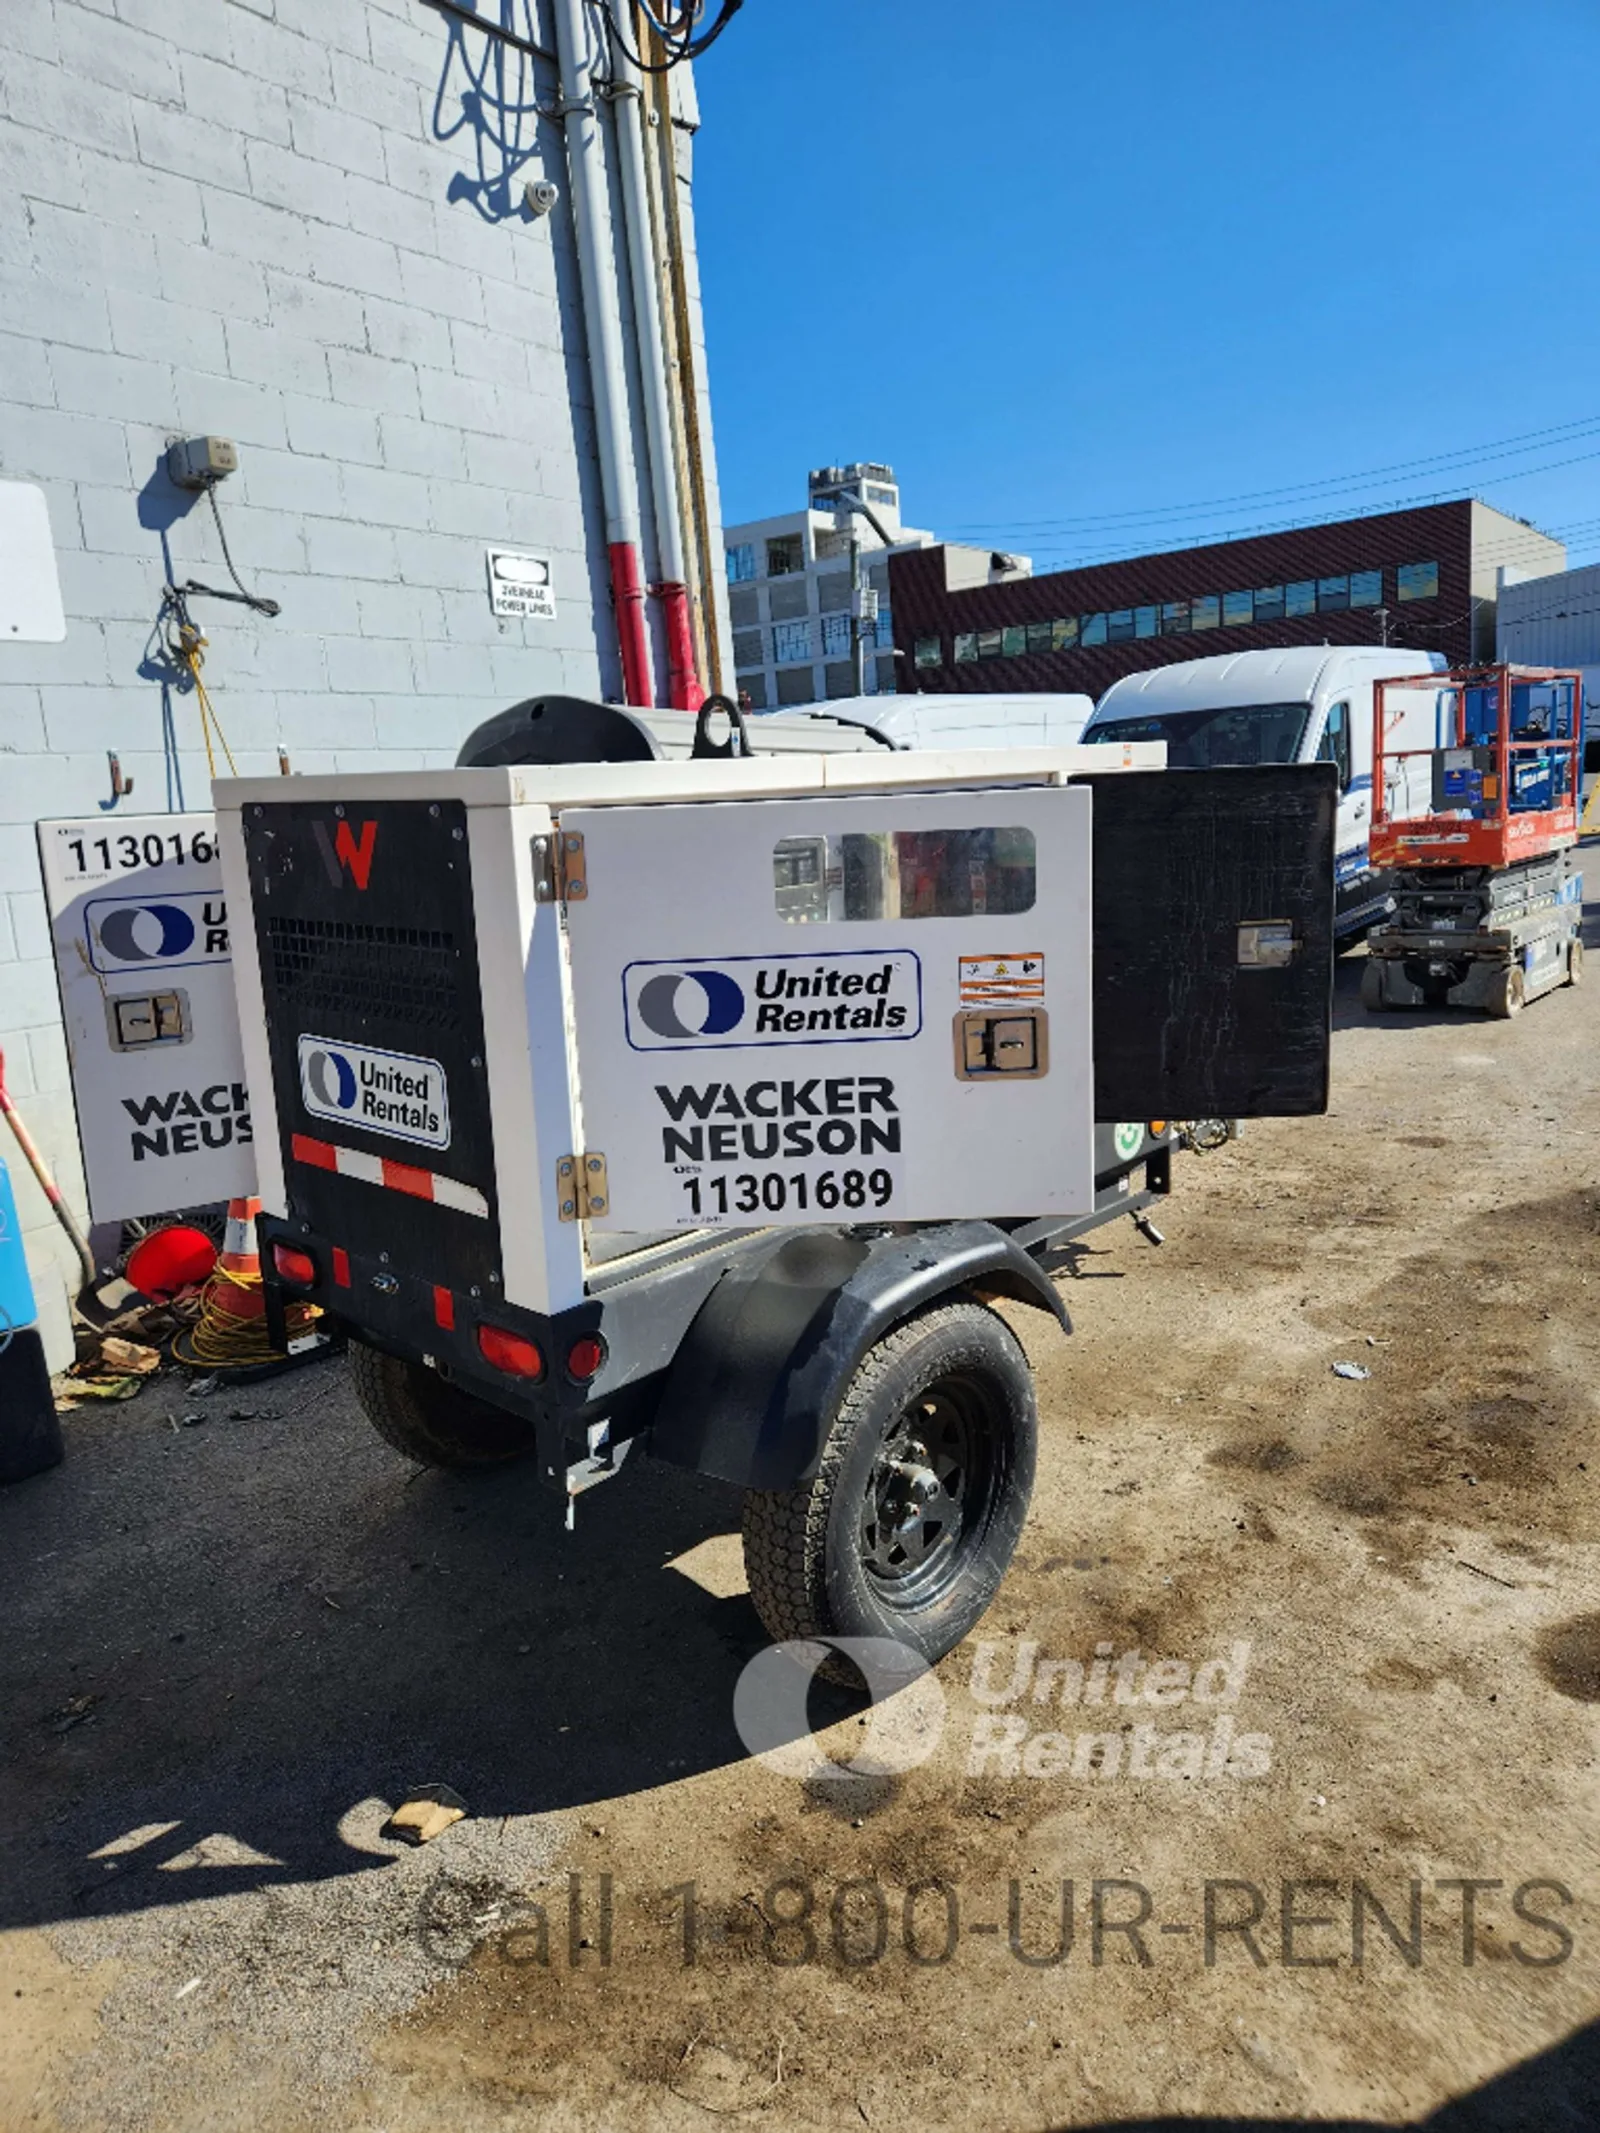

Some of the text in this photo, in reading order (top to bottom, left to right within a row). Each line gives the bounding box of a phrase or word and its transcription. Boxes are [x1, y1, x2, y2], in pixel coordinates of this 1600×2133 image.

[68, 830, 220, 872] 113016
[755, 964, 893, 1000] United
[755, 998, 907, 1034] Rentals
[360, 1060, 429, 1101] United
[654, 1077, 899, 1121] WACKER
[362, 1090, 439, 1133] Rentals
[662, 1117, 901, 1163] NEUSON
[682, 1168, 893, 1215] 11301689
